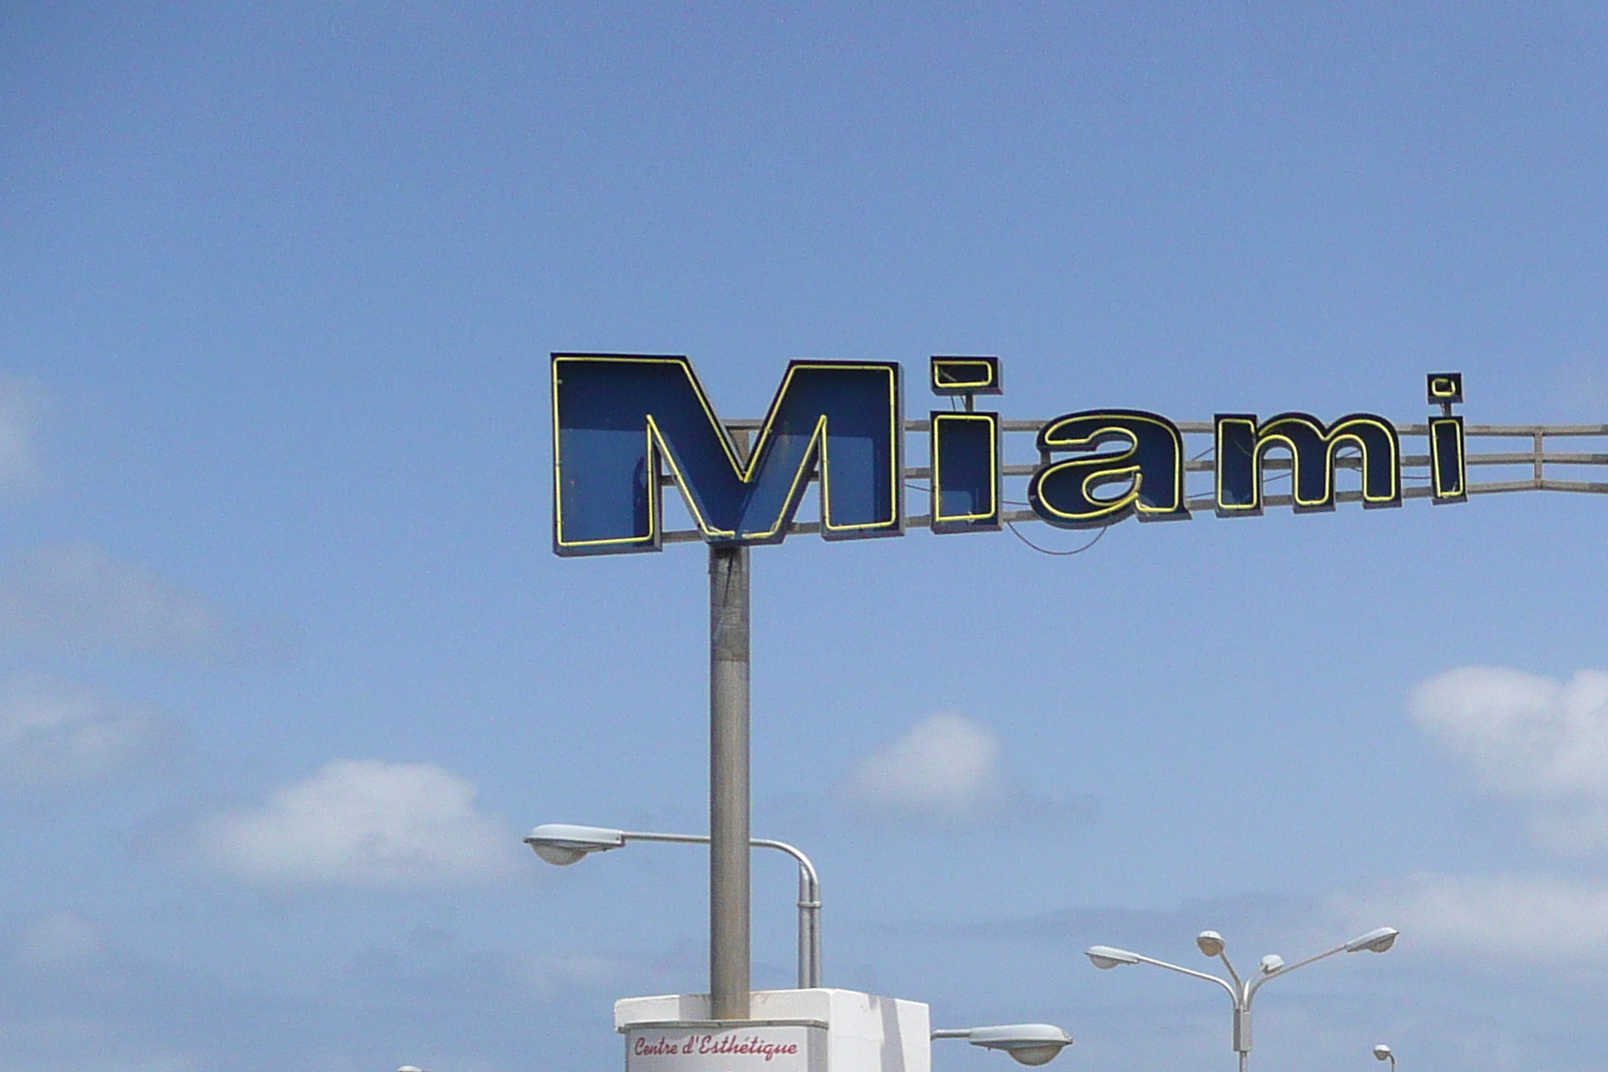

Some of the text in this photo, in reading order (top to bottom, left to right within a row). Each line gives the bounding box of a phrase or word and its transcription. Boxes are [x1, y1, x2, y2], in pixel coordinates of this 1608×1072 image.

[551, 351, 1467, 556] Miami
[634, 1035, 798, 1061] Centre d'Esthétique
